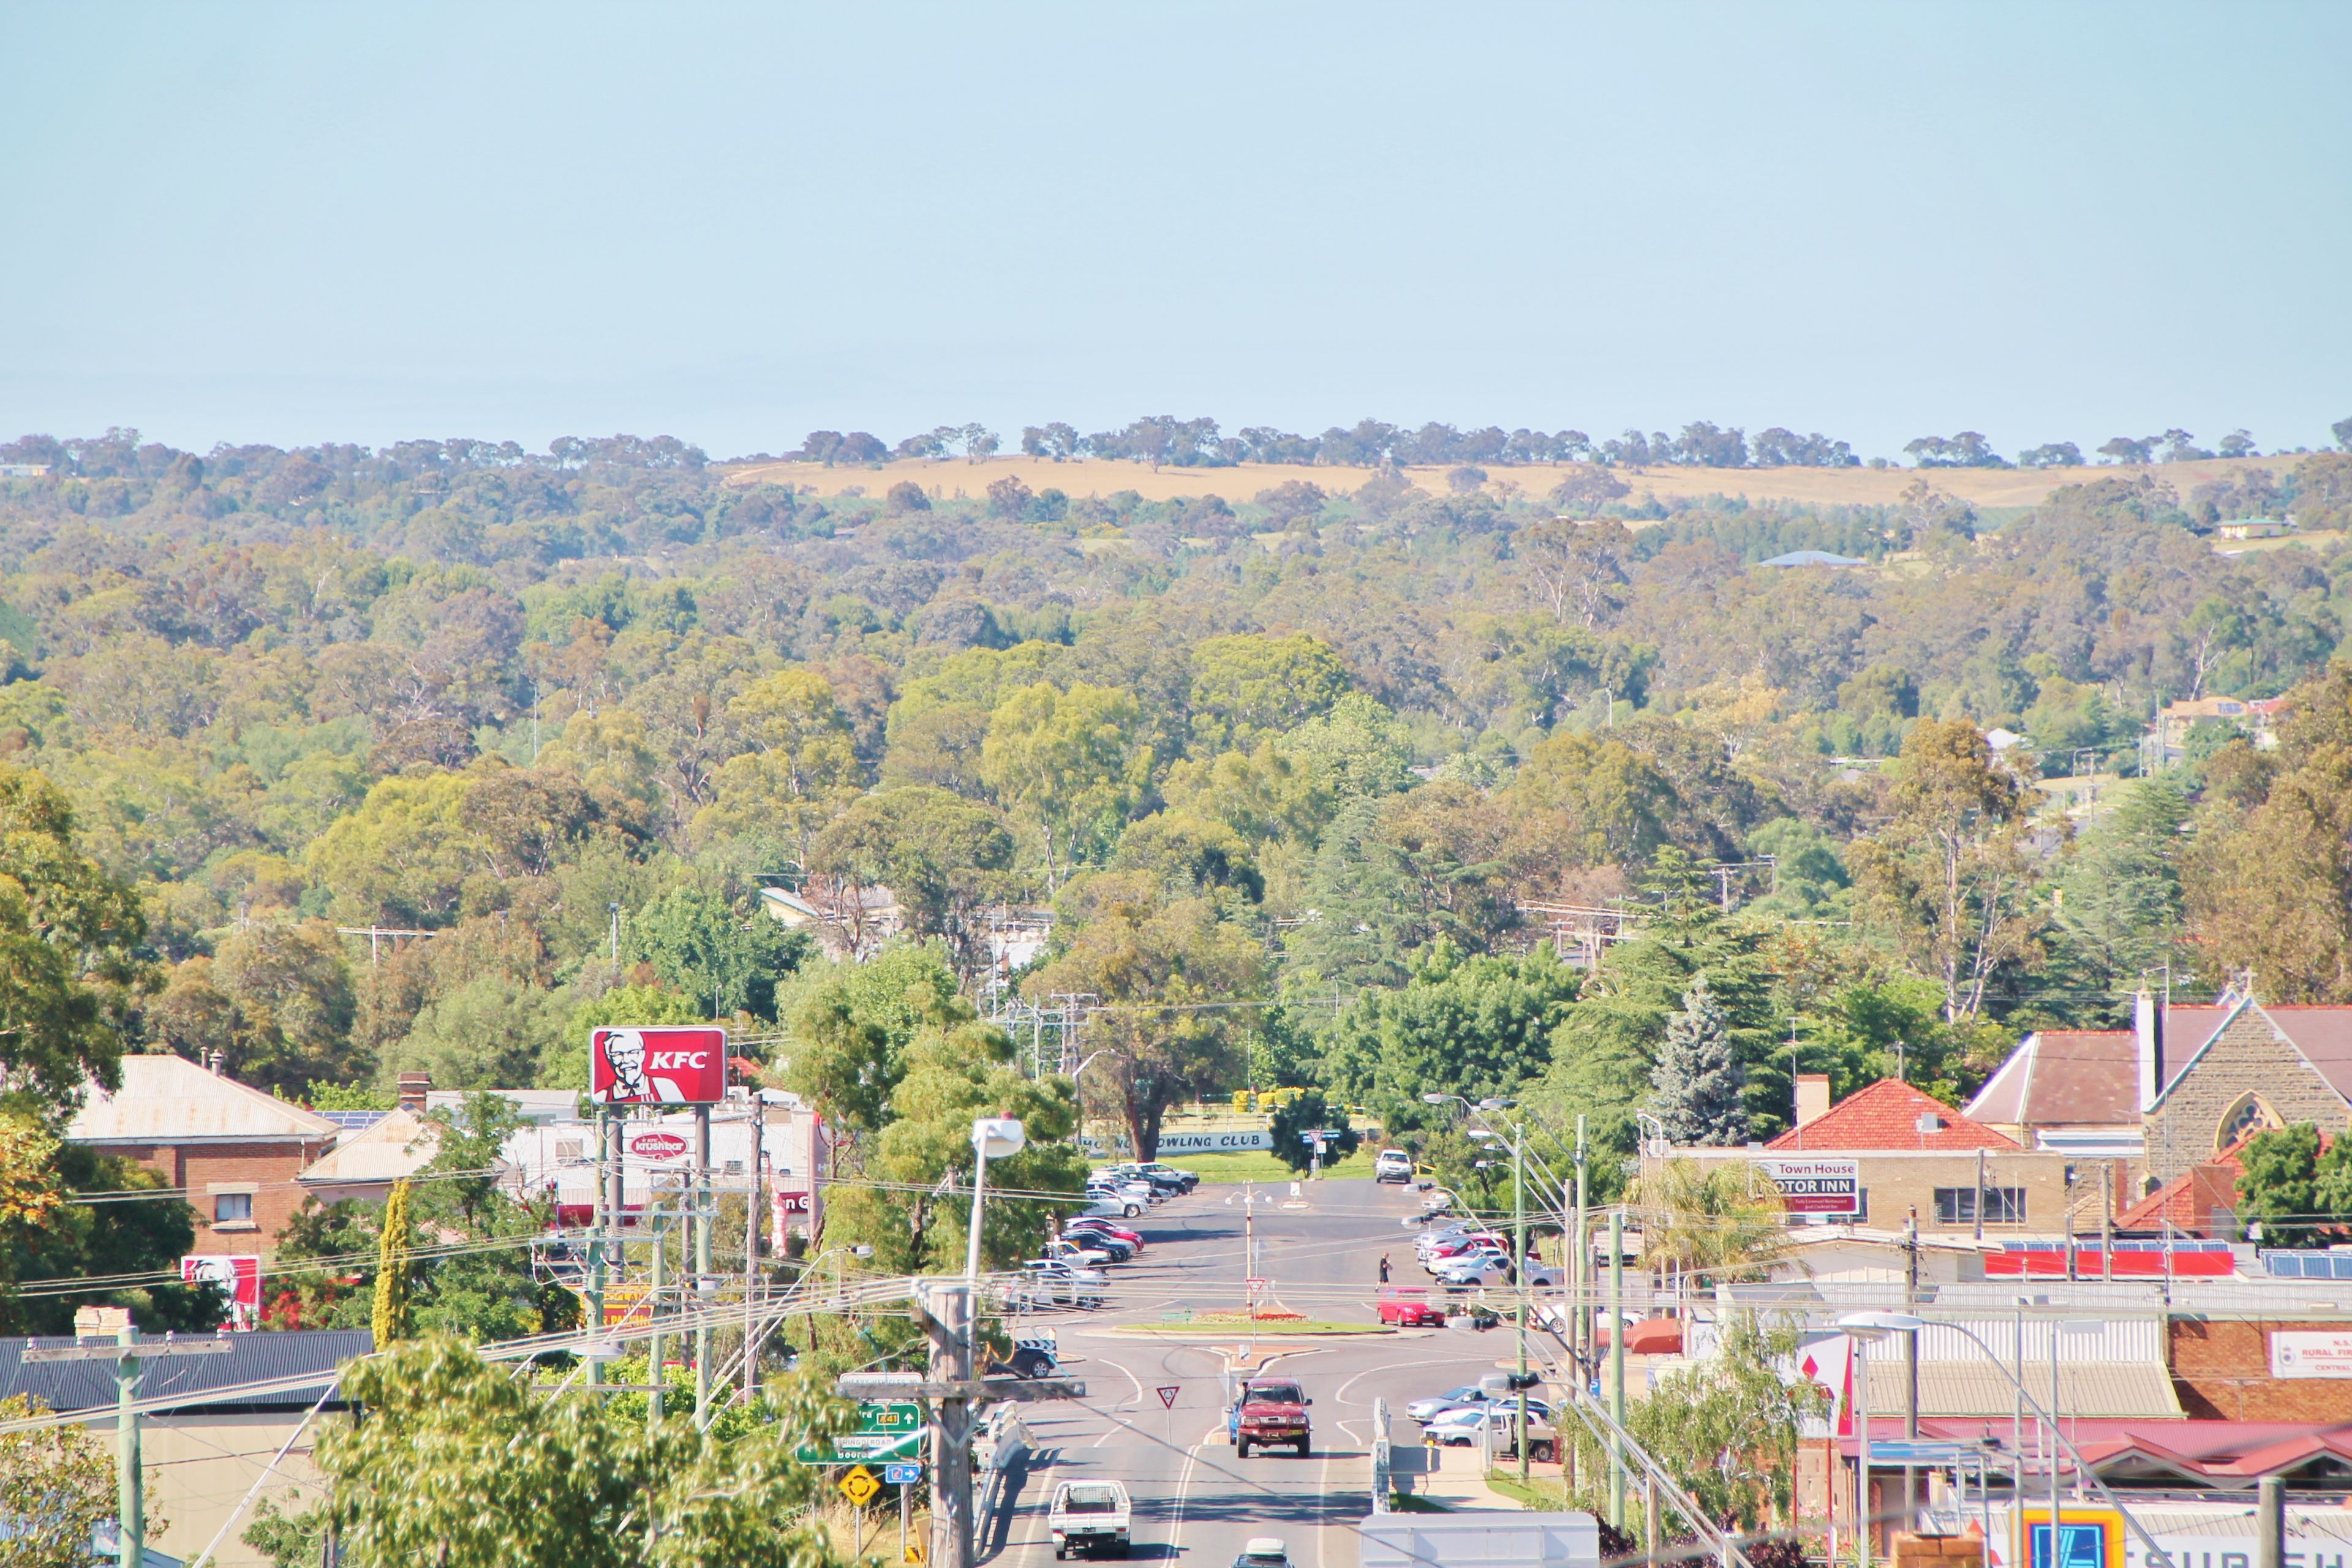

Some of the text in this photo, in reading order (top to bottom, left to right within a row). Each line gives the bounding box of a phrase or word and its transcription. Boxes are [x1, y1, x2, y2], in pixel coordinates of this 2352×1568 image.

[649, 1051, 708, 1069] KFC
[1158, 1136, 1211, 1148] OWLING
[1221, 1135, 1260, 1146] CLUB
[1779, 1164, 1855, 1174] Town House
[1776, 1180, 1850, 1193] OTOR INN
